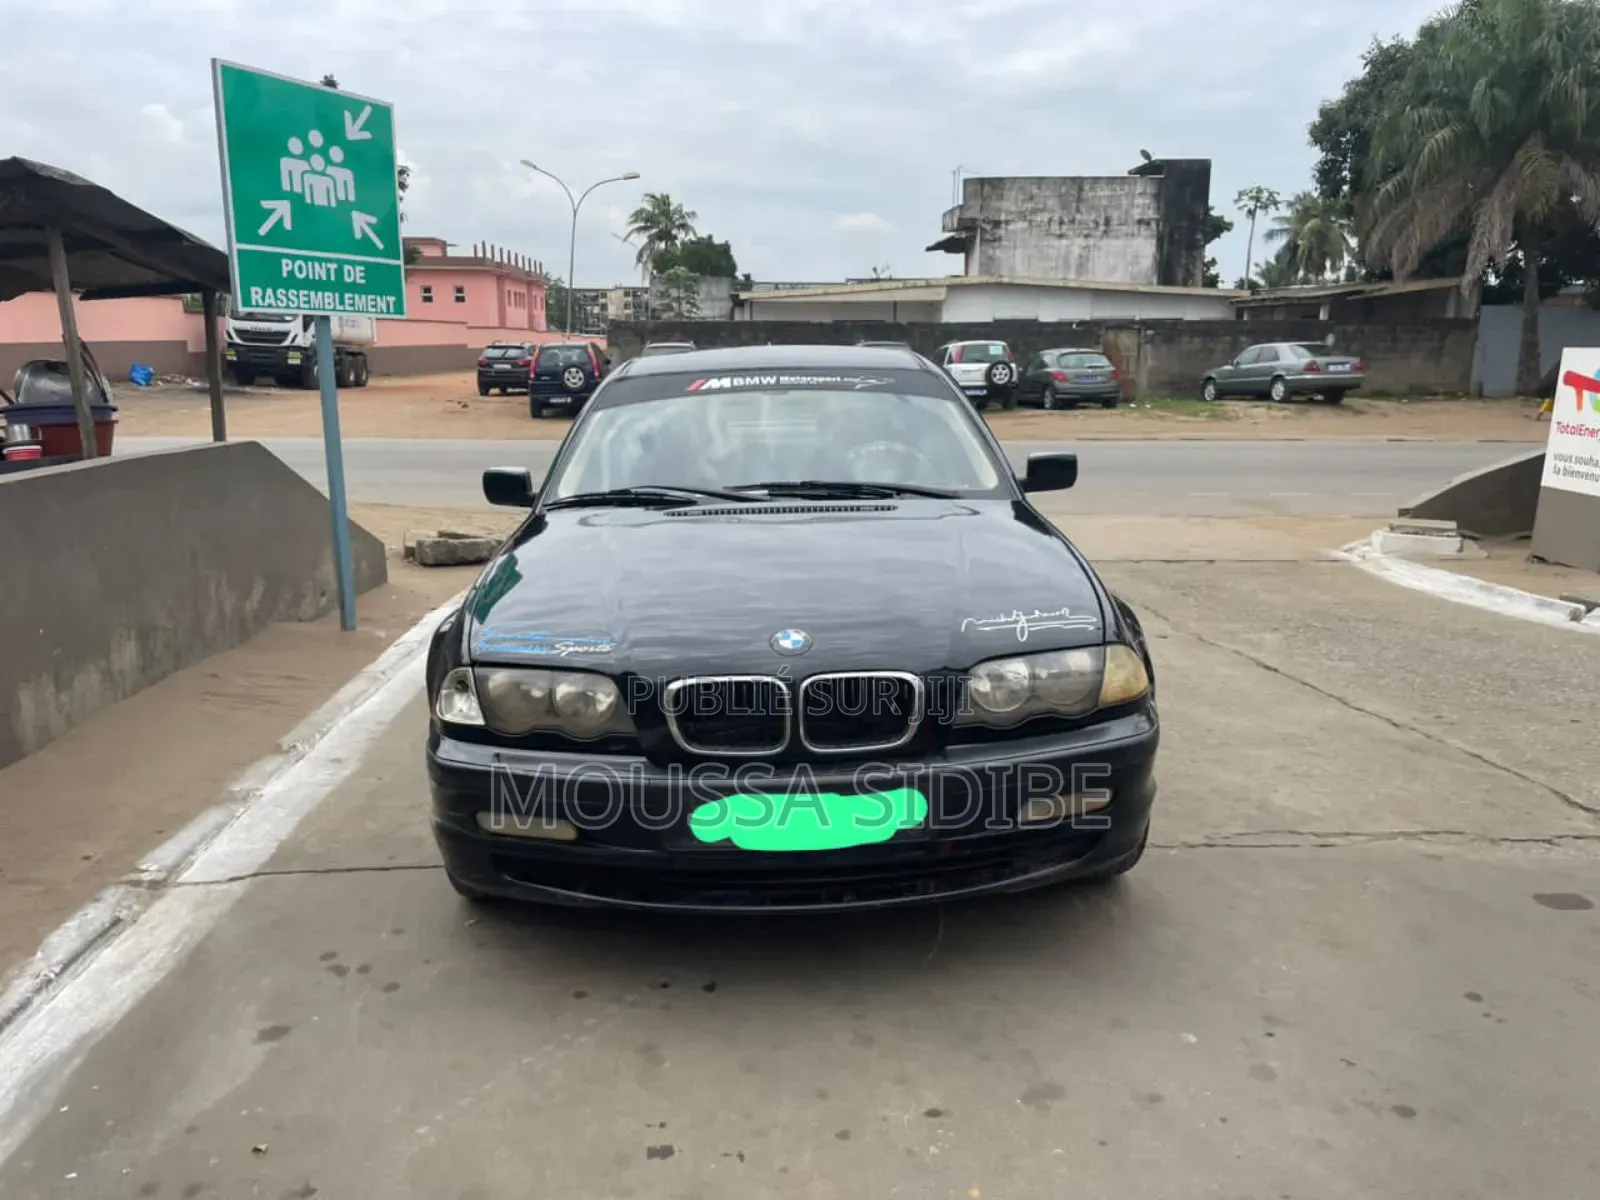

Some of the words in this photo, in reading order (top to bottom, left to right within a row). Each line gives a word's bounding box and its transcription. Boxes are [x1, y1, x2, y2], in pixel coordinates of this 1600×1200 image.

[281, 258, 338, 281] POINT
[344, 264, 366, 284] DE
[250, 287, 396, 314] RASSEMBLEMENT
[733, 375, 778, 386] BMW
[1555, 420, 1600, 442] TotalEner
[1554, 452, 1573, 463] vous
[1575, 455, 1600, 469] souha
[1553, 464, 1561, 475] la
[1563, 465, 1600, 482] bienvenu
